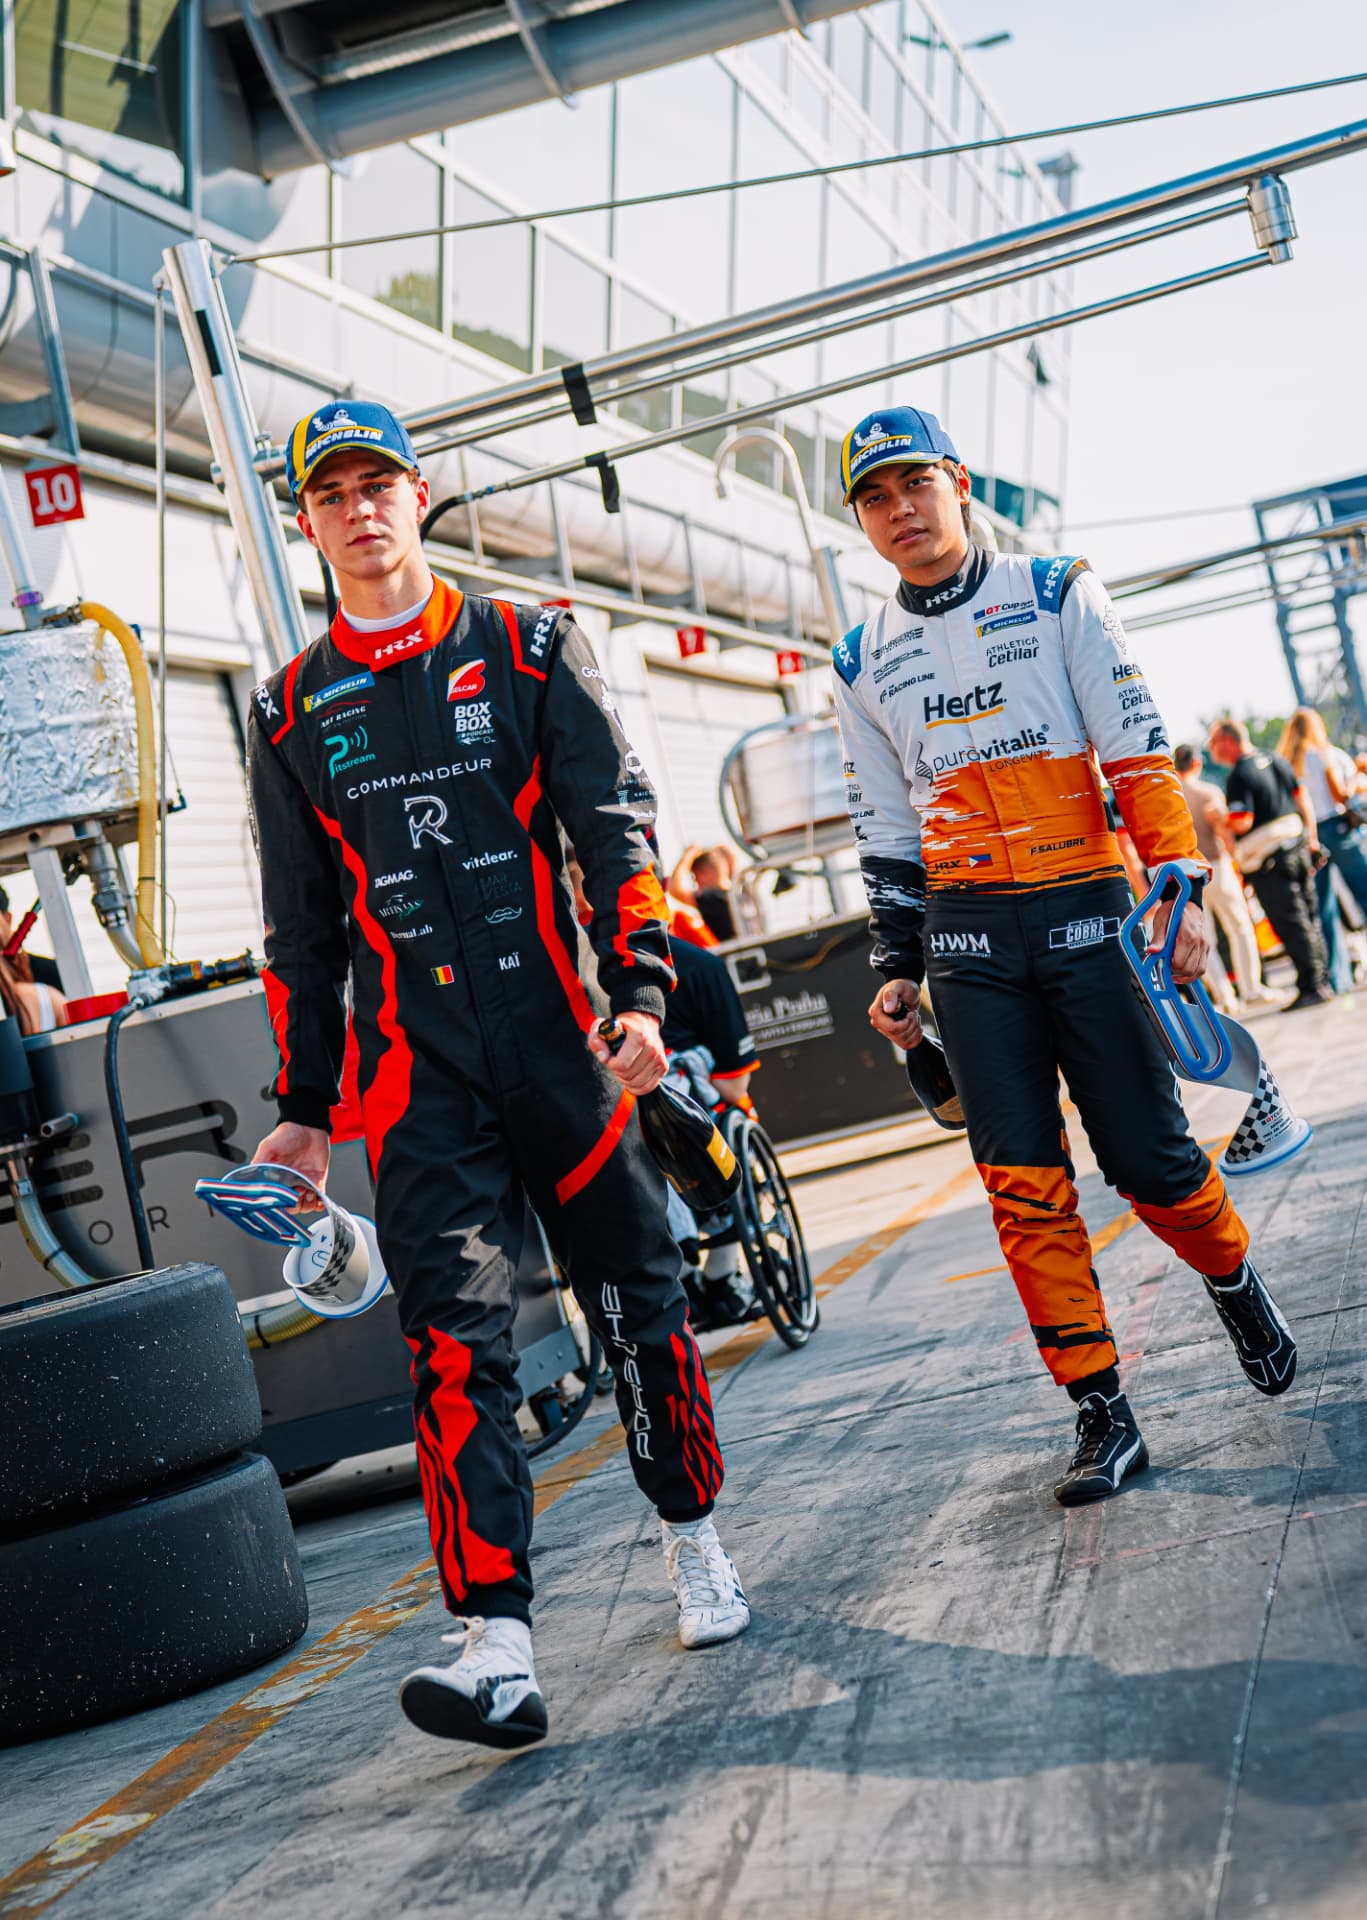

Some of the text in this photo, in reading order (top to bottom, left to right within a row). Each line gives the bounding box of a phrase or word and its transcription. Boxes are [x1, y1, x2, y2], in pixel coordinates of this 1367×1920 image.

[305, 430, 382, 459] MICHELIN
[851, 438, 911, 473] MICHELIN
[31, 473, 77, 516] 10
[925, 583, 965, 609] HRX
[374, 629, 424, 660] HRX
[530, 607, 558, 658] HRX
[986, 635, 1039, 657] ATHLETICA
[322, 677, 368, 699] MICHELIN
[888, 672, 936, 697] RACING LINE
[454, 701, 491, 719] BOX
[455, 714, 493, 732] BOX
[990, 748, 1051, 772] LONGEVITY
[347, 758, 493, 800] COMMANDEUR
[930, 933, 991, 953] HWM
[1066, 922, 1105, 942] COBRA
[499, 952, 521, 971] KAÏ
[601, 1281, 654, 1461] PORSCHE
